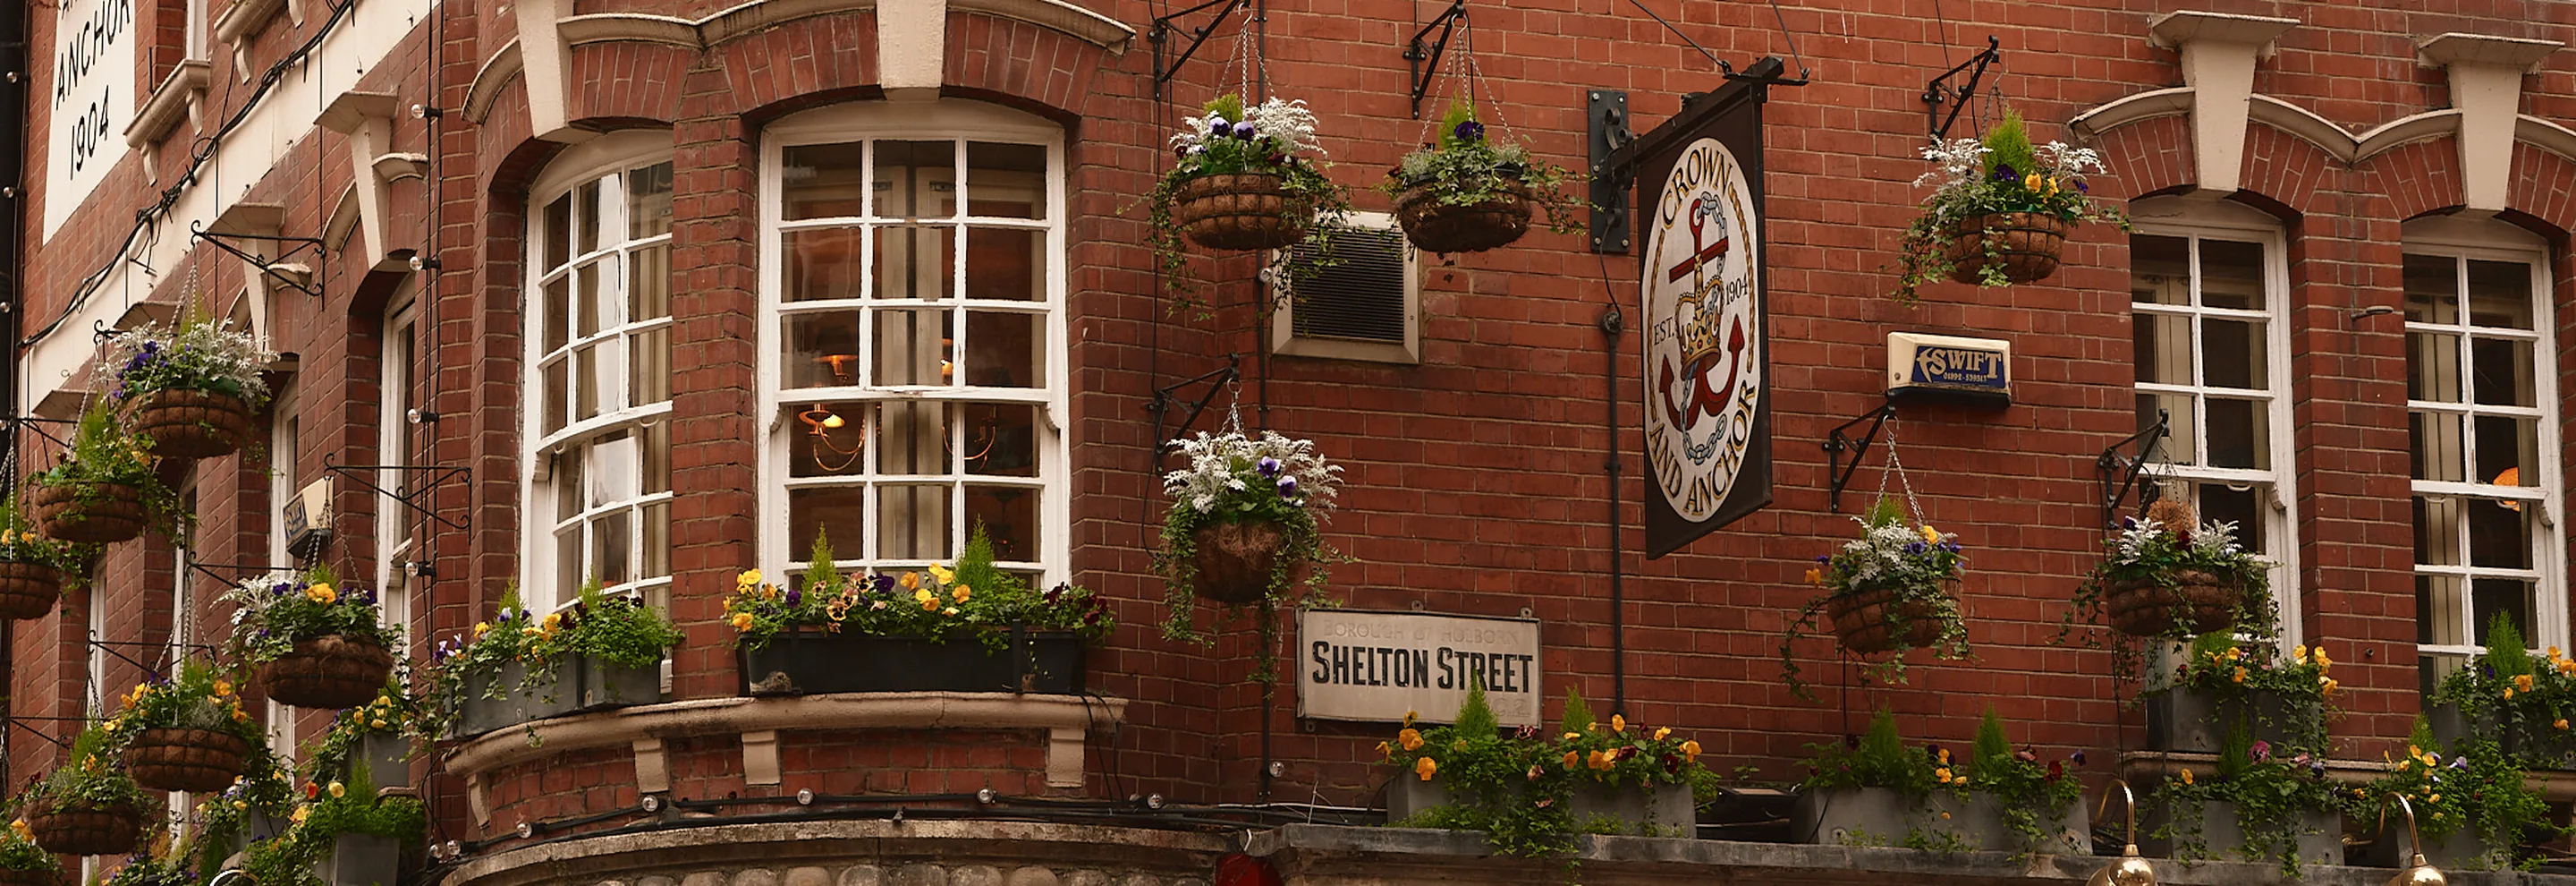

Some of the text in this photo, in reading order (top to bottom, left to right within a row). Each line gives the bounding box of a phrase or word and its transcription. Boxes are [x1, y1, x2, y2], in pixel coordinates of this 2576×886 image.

[70, 84, 109, 181] 1904
[1662, 147, 1733, 230] CROWN
[1725, 272, 1748, 305] 1904
[1654, 316, 1675, 346] EST.
[1929, 348, 2002, 379] SWIFT
[1648, 379, 1756, 517] AND ANCHOR
[1324, 619, 1403, 641] BOROUGH
[1440, 627, 1520, 645] HOLBORN
[1312, 640, 1533, 693] SHELTON STREET
